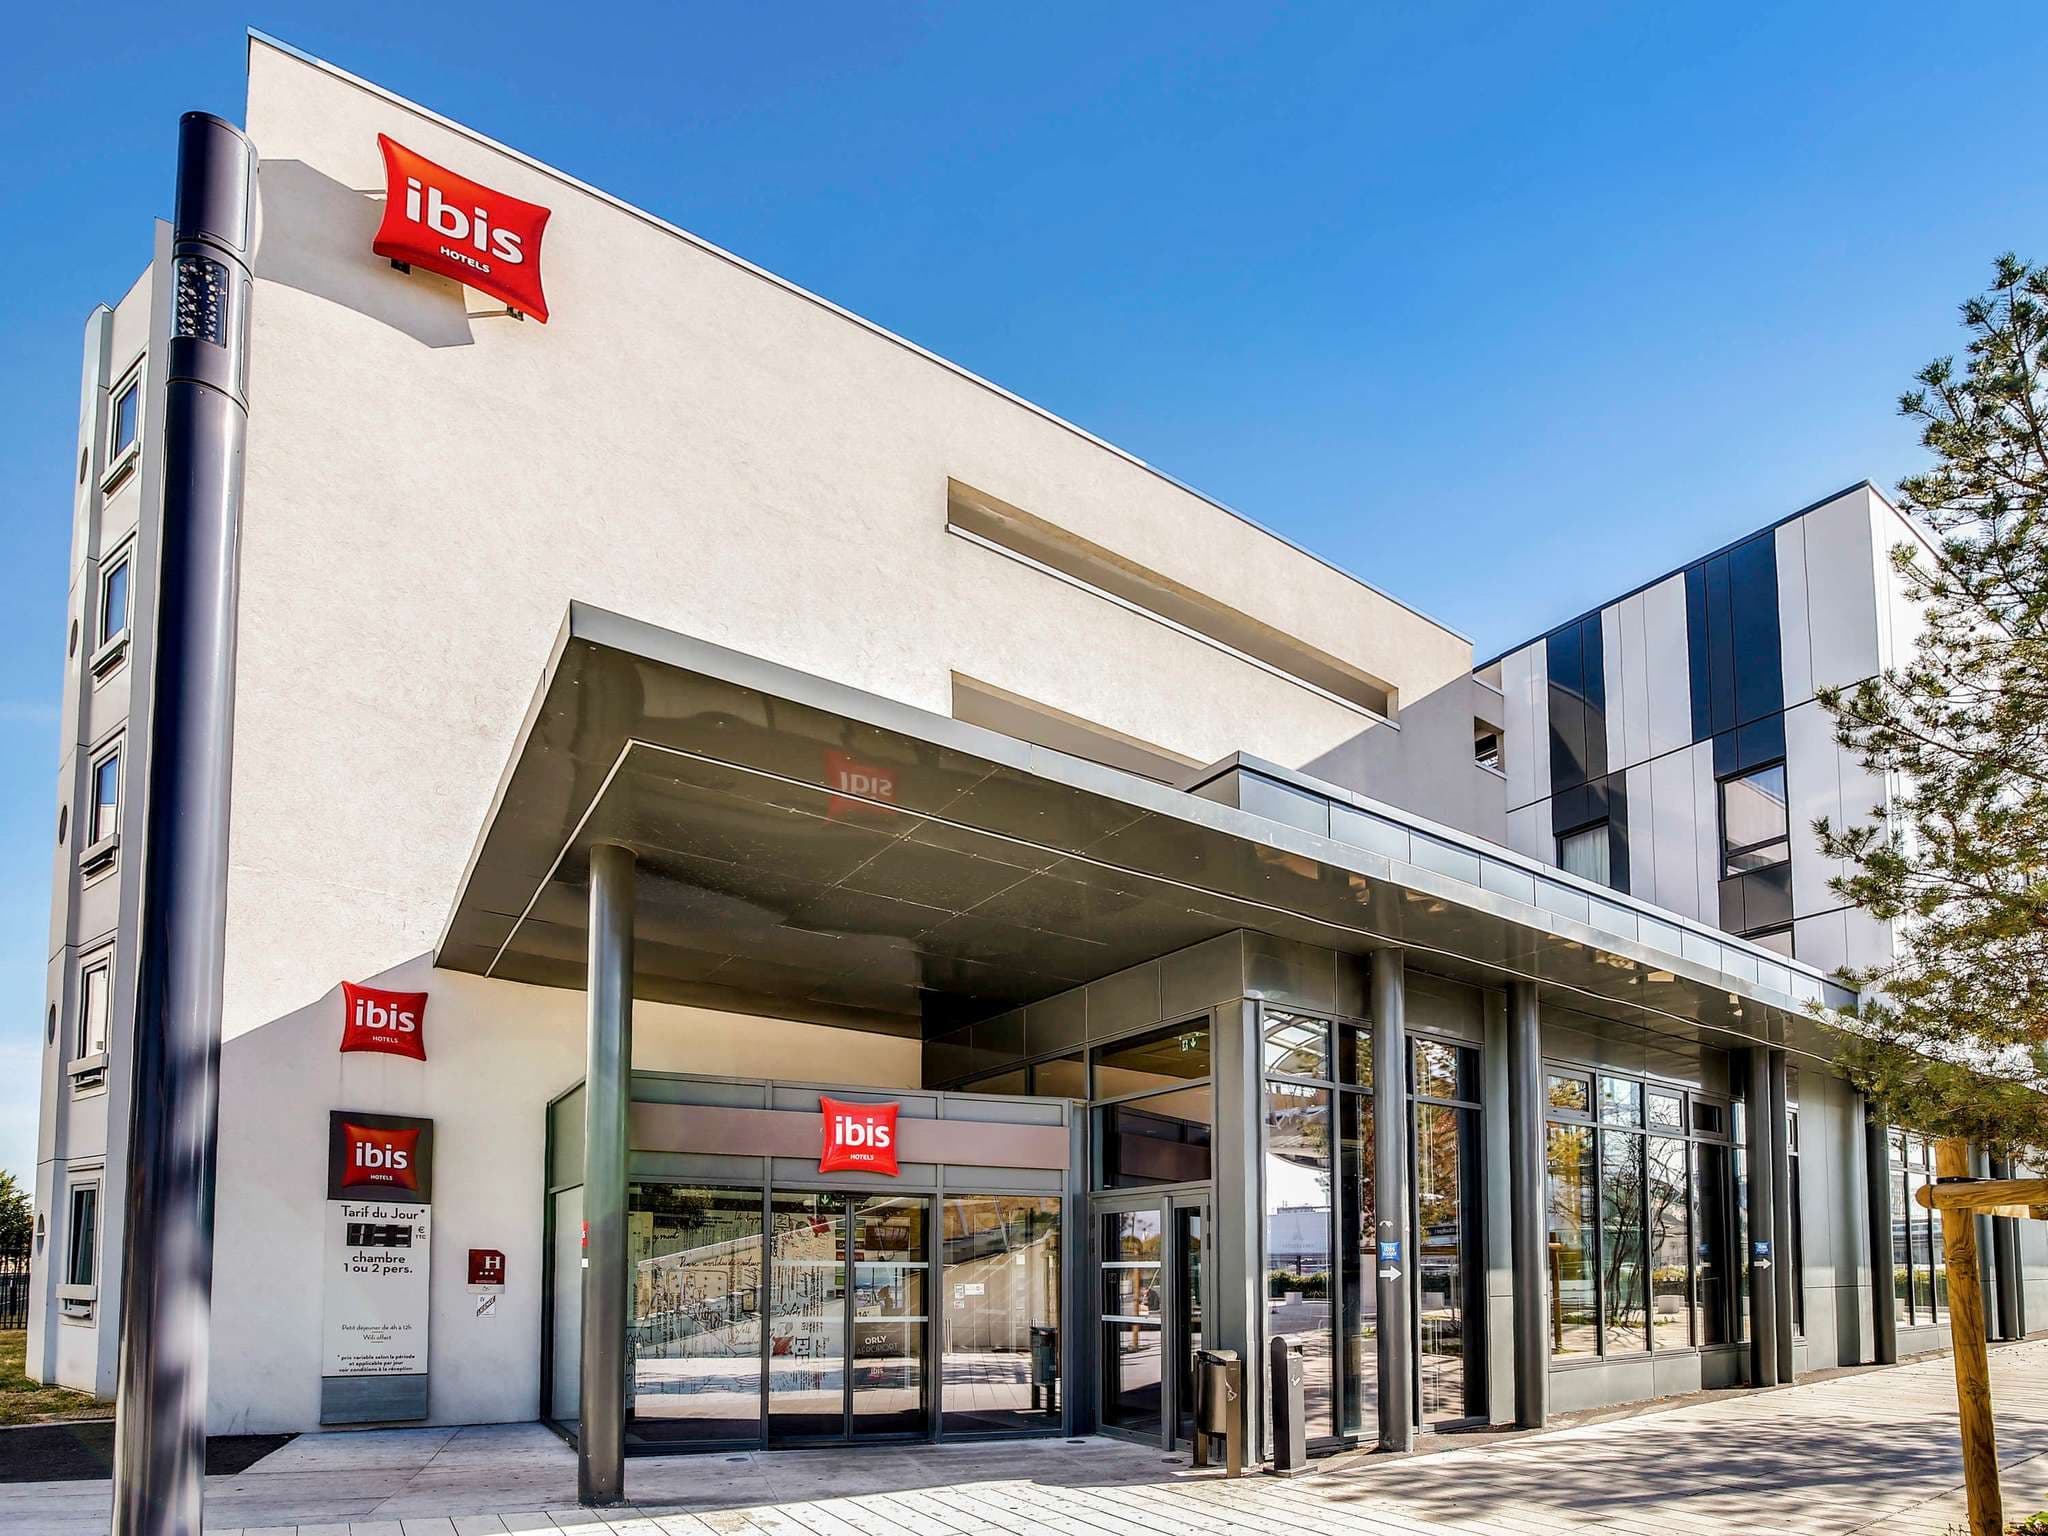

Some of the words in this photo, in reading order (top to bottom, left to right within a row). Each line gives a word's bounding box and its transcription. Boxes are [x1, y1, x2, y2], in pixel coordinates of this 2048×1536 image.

[406, 176, 524, 264] ibis
[440, 246, 491, 273] HOTELS
[355, 999, 416, 1033] ibis
[372, 1035, 399, 1044] HOTELS
[835, 1115, 890, 1148] ibis
[356, 1142, 408, 1169] ibis
[850, 1153, 875, 1161] HOTELS
[341, 1205, 369, 1218] Tarif
[372, 1206, 387, 1218] du
[352, 1250, 406, 1264] chambre
[484, 1256, 501, 1269] H
[344, 1263, 349, 1273] 1
[352, 1265, 368, 1273] ou
[372, 1264, 380, 1273] 2
[383, 1265, 413, 1276] pers.
[864, 1335, 887, 1345] ORLY
